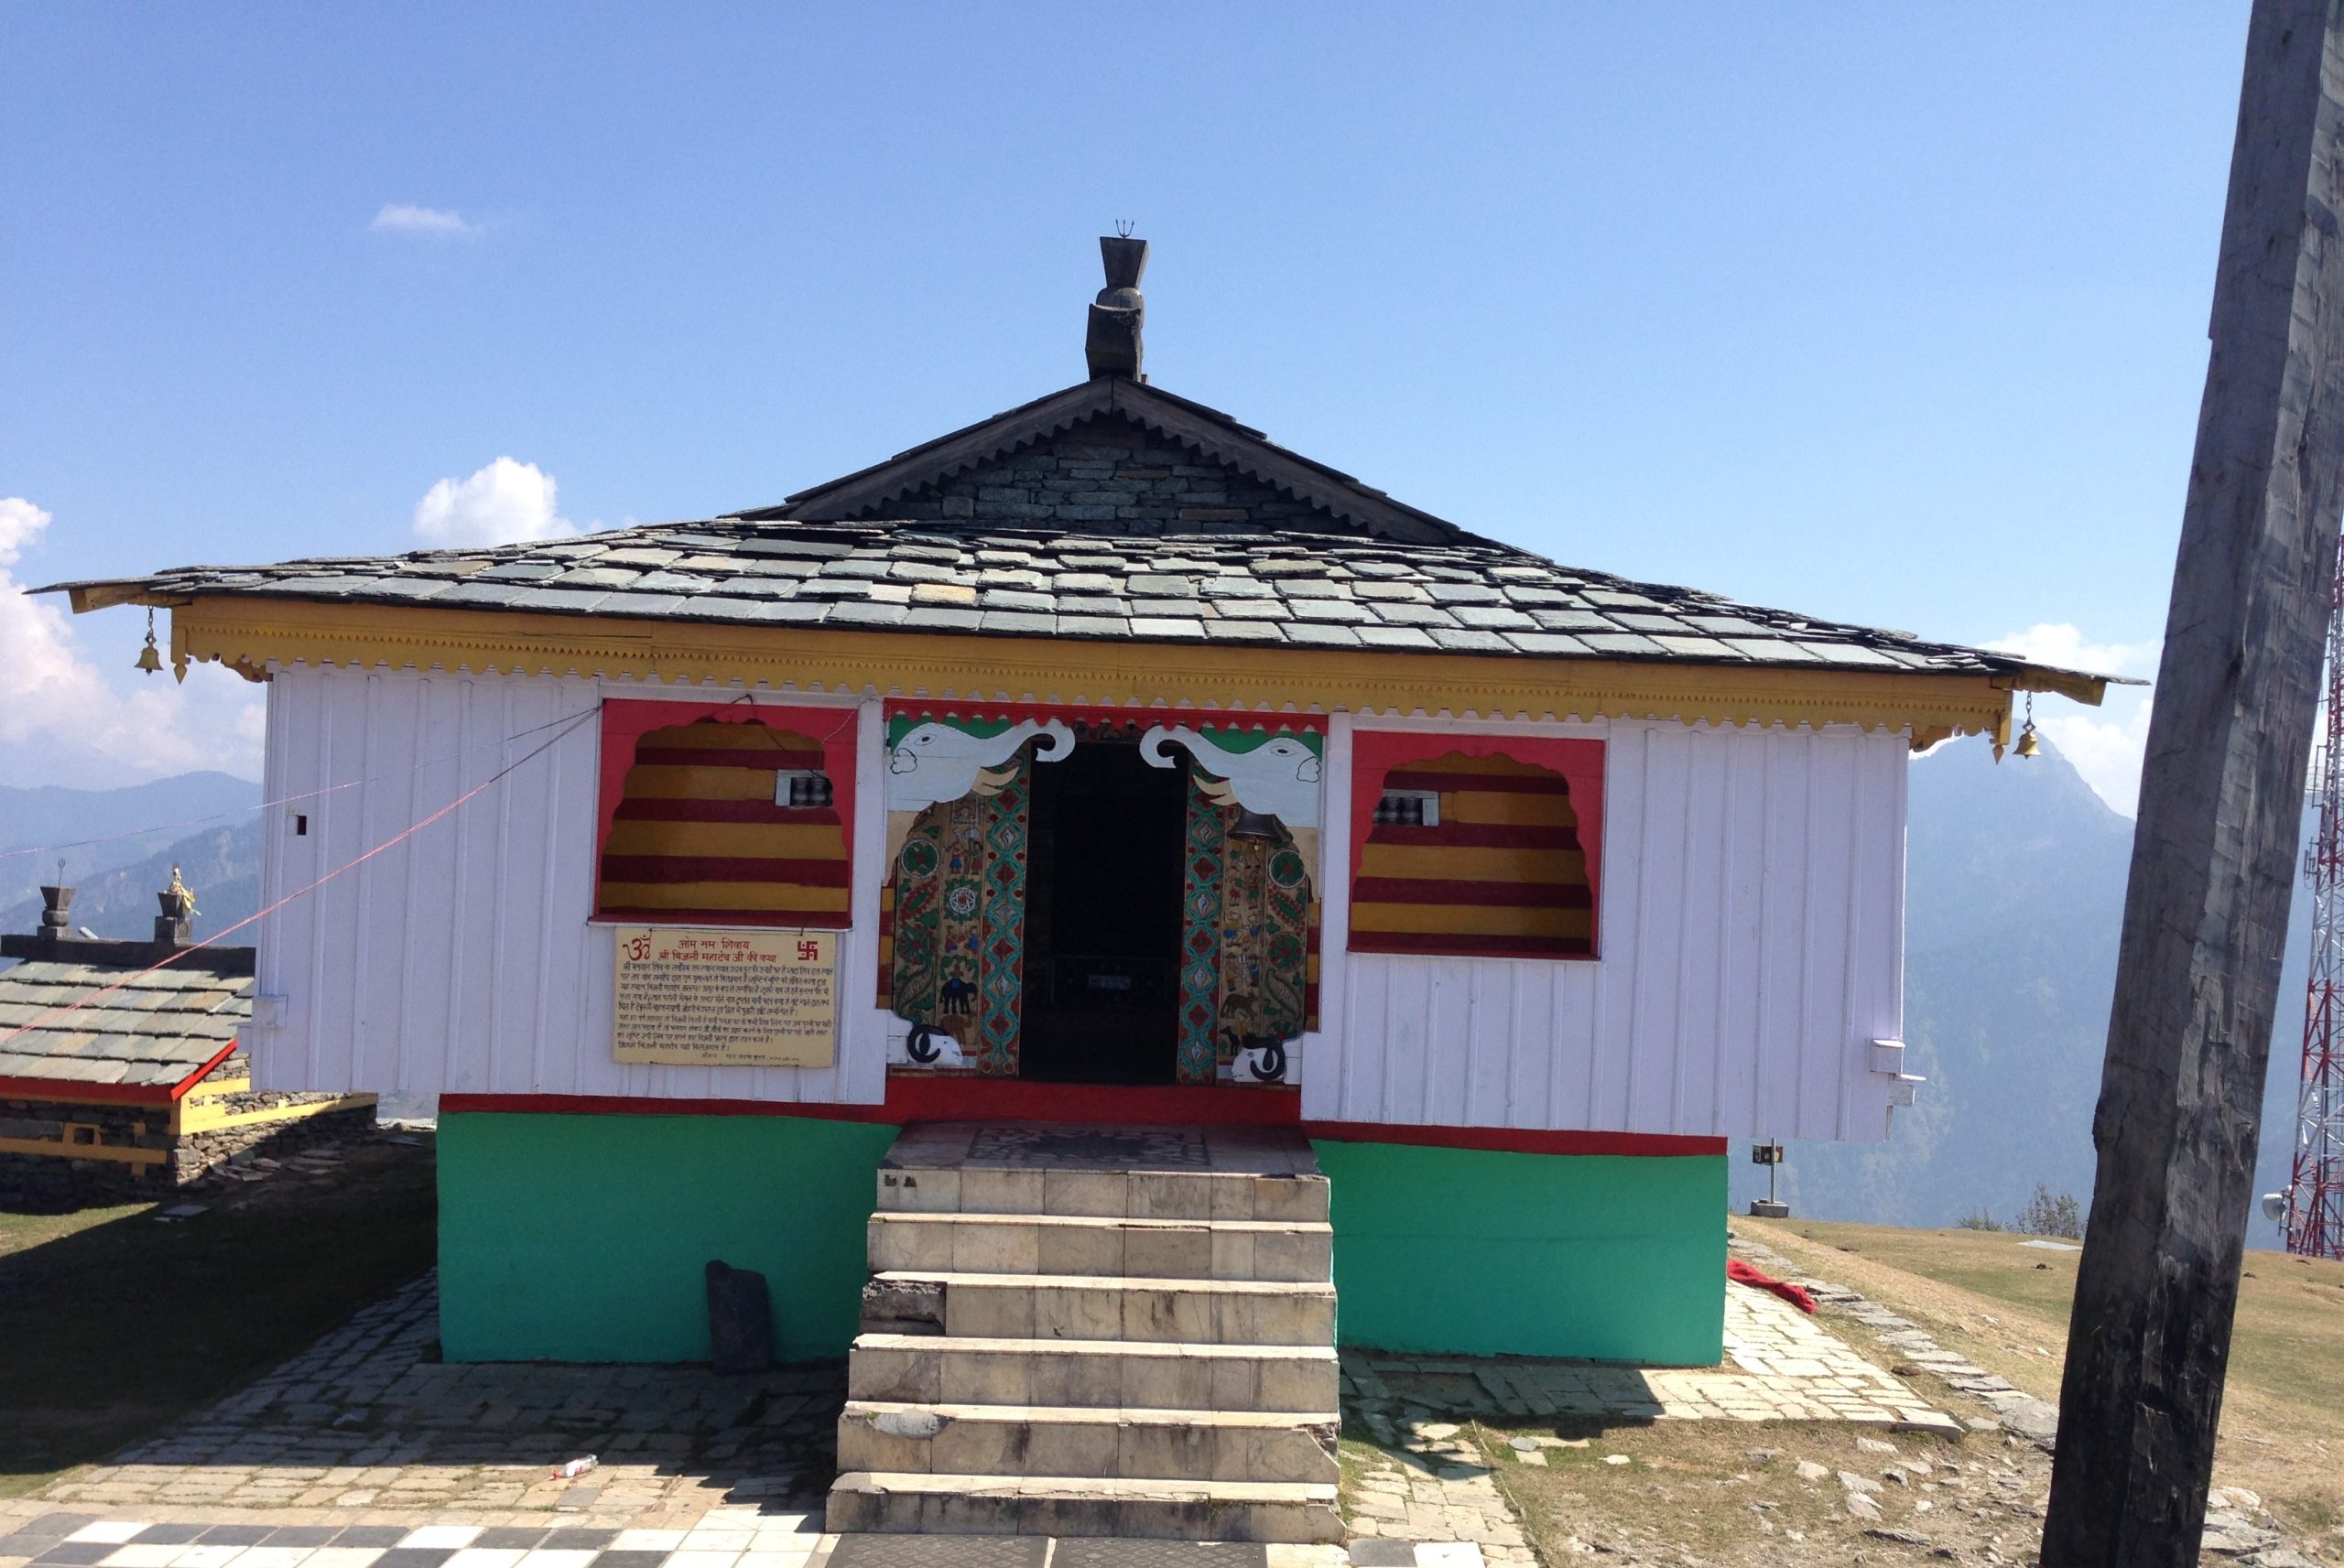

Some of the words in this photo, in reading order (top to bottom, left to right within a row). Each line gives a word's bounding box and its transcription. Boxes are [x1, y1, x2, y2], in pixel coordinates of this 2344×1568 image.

[721, 937, 750, 949] शिवाय
[658, 949, 669, 961] श्री
[672, 949, 699, 961] बिजली
[701, 951, 730, 962] महादेव
[732, 951, 744, 962] जी
[746, 951, 757, 962] की
[759, 954, 776, 963] कथा
